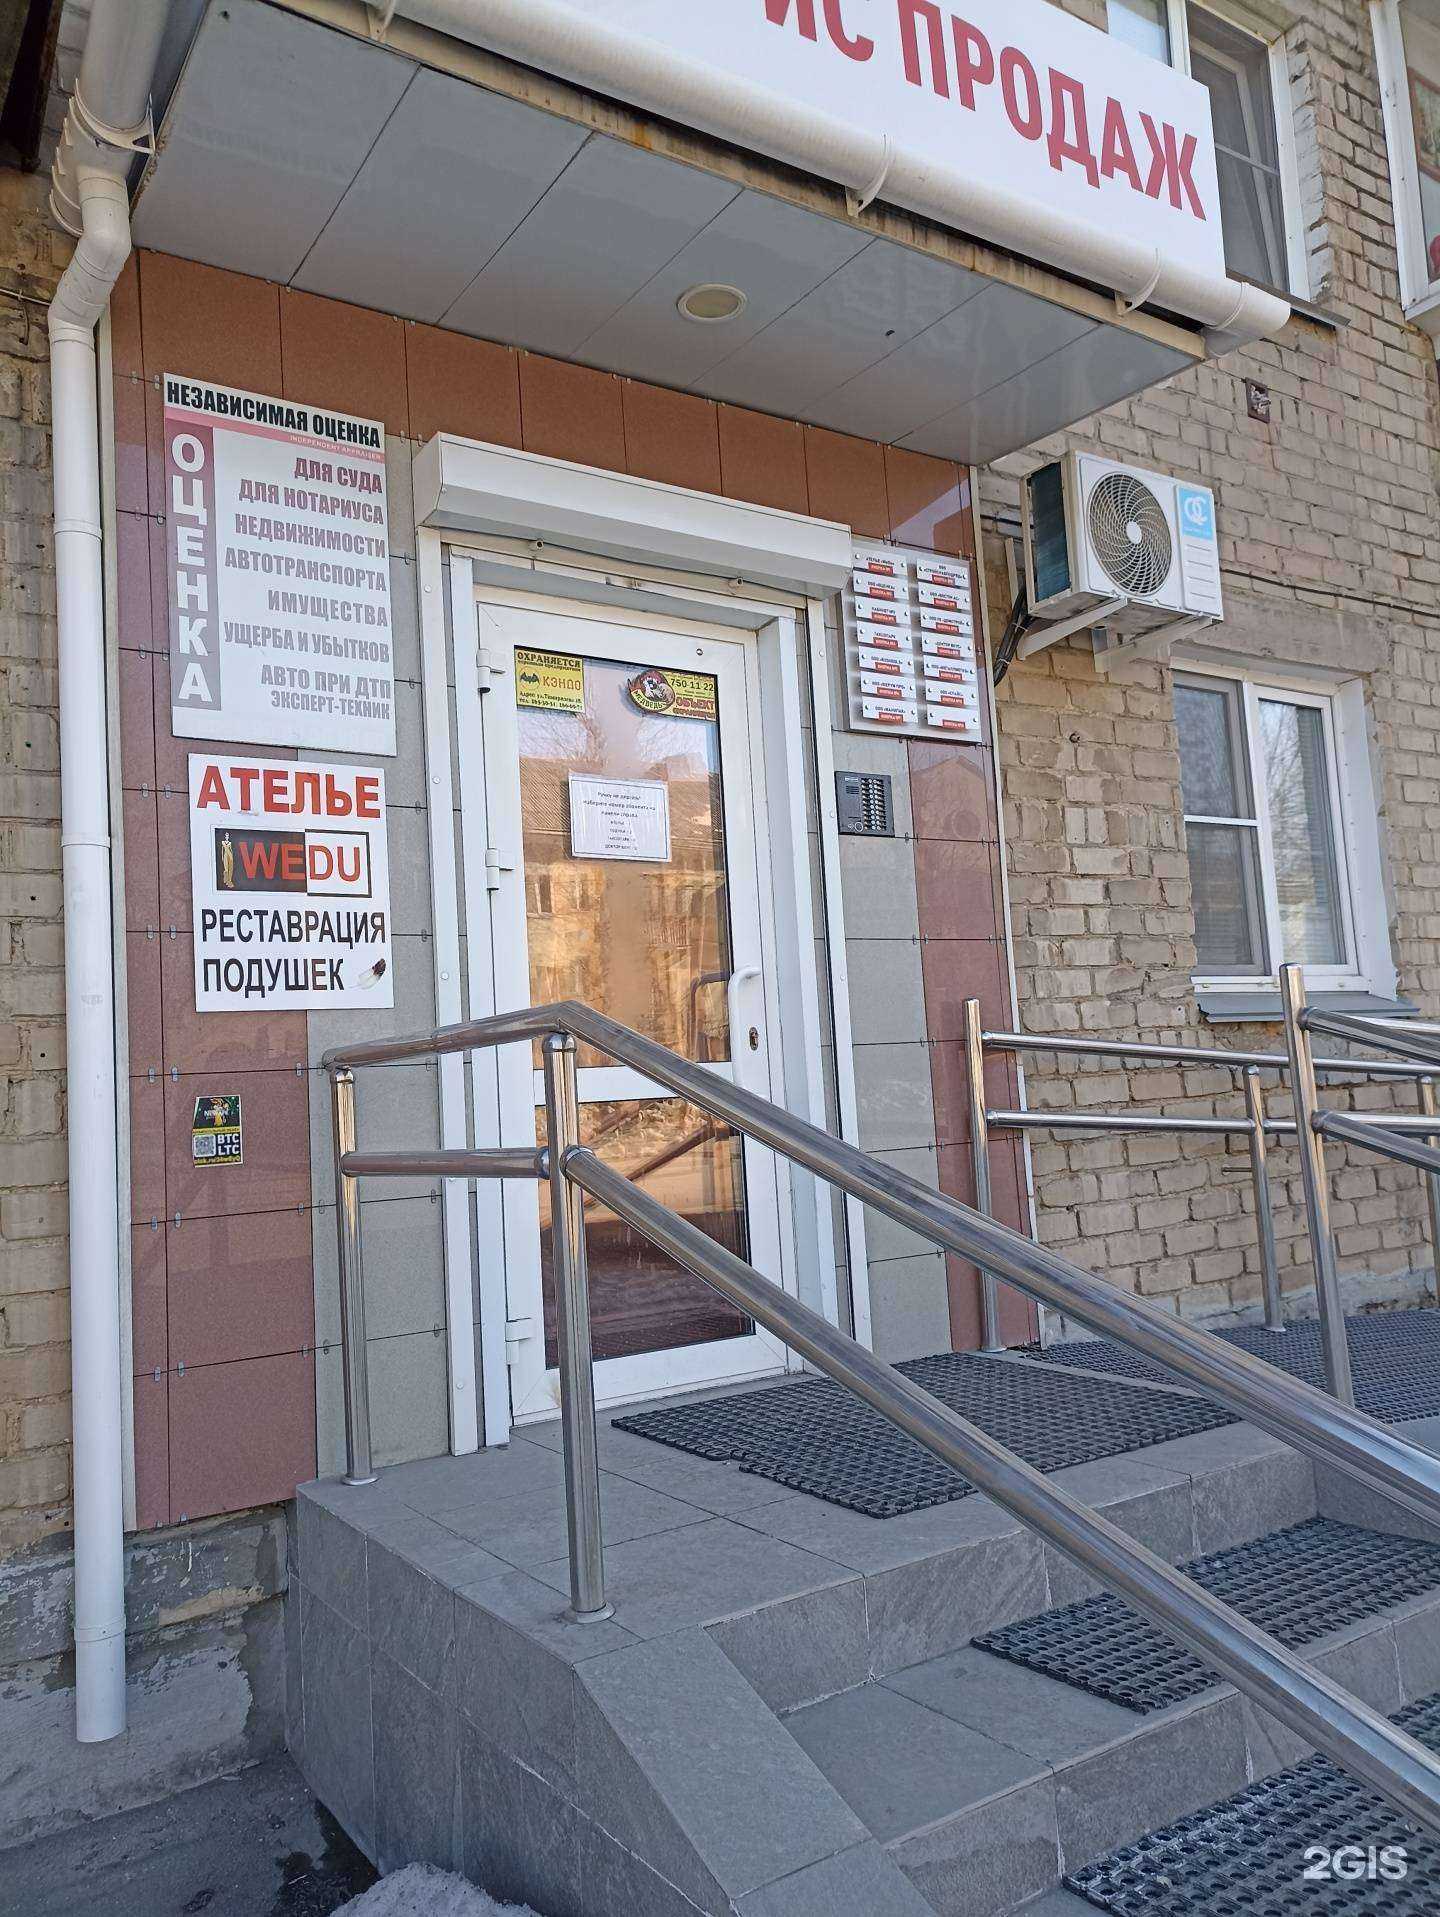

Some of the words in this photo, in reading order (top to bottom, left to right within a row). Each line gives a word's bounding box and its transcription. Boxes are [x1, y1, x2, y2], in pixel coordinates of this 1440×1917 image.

[897, 0, 1206, 220] ПРОДАЖ
[167, 381, 308, 433] НЕЗАВИСИМАЯ
[312, 413, 381, 449] ОЦЕНКА
[294, 457, 333, 484] ДЛЯ
[336, 465, 383, 495] СУДА
[239, 479, 279, 505] ДЛЯ
[284, 486, 384, 525] НОТАРИУСА
[235, 513, 386, 559] НЕДВИЖИМОСТИ
[171, 433, 213, 702] ОЦЕНКА
[224, 547, 387, 592] АВТОТРАНСПОРТА
[268, 590, 388, 628] ИМУЩЕСТВА
[224, 621, 293, 651] УЩЕРБА
[297, 630, 309, 652] И
[312, 632, 390, 663] УБЫТКОВ
[517, 651, 581, 668] ОХРАНЯЕТСЯ
[261, 664, 309, 690] АВТО
[314, 670, 350, 694] ПРИ
[354, 674, 391, 699] ДТП
[542, 676, 582, 690] КЭНДО
[271, 690, 390, 719] ЭКСПЕРТ-ТЕХНИК
[197, 765, 381, 818] АТЕЛЬЕ
[239, 841, 361, 882] WEDU
[201, 908, 386, 949] РЕСТАВРАЦИЯ
[203, 958, 344, 998] ПОДУШЕК
[217, 1134, 239, 1144] BTC
[218, 1145, 240, 1155] LTC
